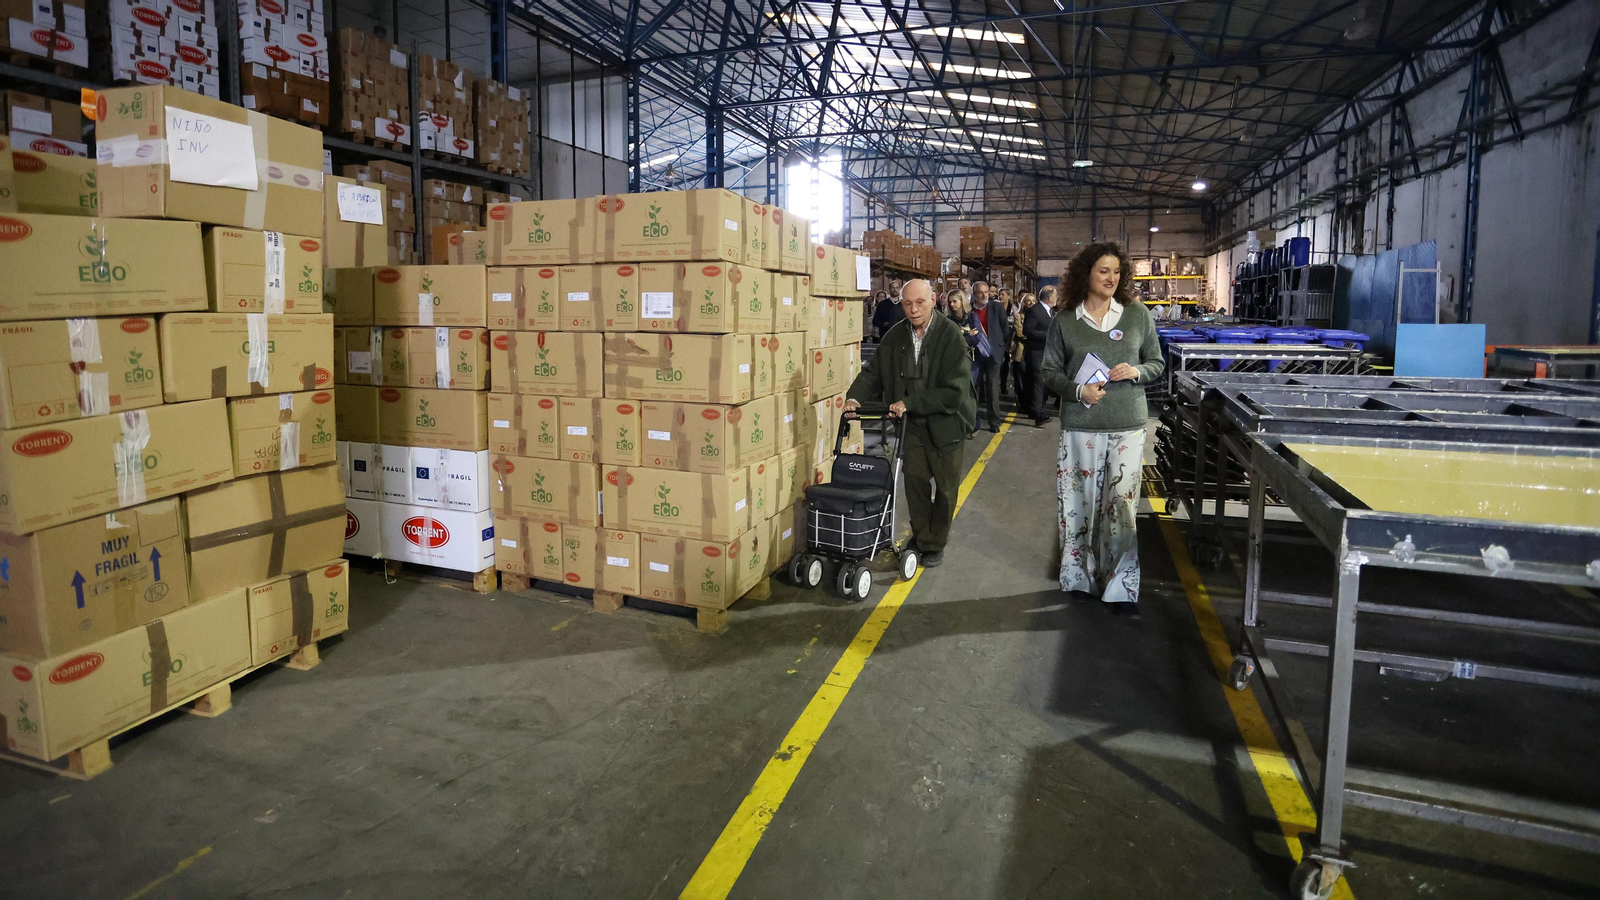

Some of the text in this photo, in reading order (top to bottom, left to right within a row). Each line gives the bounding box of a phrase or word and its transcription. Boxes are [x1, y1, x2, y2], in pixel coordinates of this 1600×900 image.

[136, 10, 163, 22] TORRENT
[35, 33, 70, 47] TORENT
[179, 49, 204, 60] TORRENT
[139, 63, 167, 75] TORRENT
[131, 92, 143, 119] ECO
[172, 118, 211, 133] NIÑO
[178, 139, 209, 153] INV
[528, 229, 551, 243] ECO
[643, 223, 669, 237] ECO
[78, 262, 127, 283] ECO
[298, 280, 319, 292] ECO
[538, 302, 554, 313] ECO
[616, 301, 634, 312] ECO
[700, 302, 720, 314] ECO
[750, 298, 762, 312] ECO
[2, 326, 35, 334] FRÁGIL
[242, 340, 276, 354] EO
[457, 362, 473, 373] ECO
[534, 363, 557, 376] ECO
[656, 367, 683, 382] ECO
[124, 367, 154, 383] ECO
[416, 414, 436, 428] ECO
[19, 434, 68, 450] TORRENT
[312, 431, 332, 444] ECO
[538, 433, 554, 443] ECO
[751, 429, 764, 443] ECO
[616, 439, 634, 451] ECO
[701, 445, 720, 456] ECO
[382, 465, 405, 473] FRÁGIL
[531, 489, 553, 502] ECO
[654, 502, 679, 517] ECO
[406, 524, 444, 539] TORRENT
[101, 535, 129, 555] MUY
[565, 538, 580, 549] ECO
[94, 552, 140, 576] FRAGIL
[543, 555, 560, 566] ECO
[701, 580, 720, 593] ECO
[325, 604, 344, 618] ECO
[55, 657, 99, 680] TORRENT
[142, 659, 183, 687] EO
